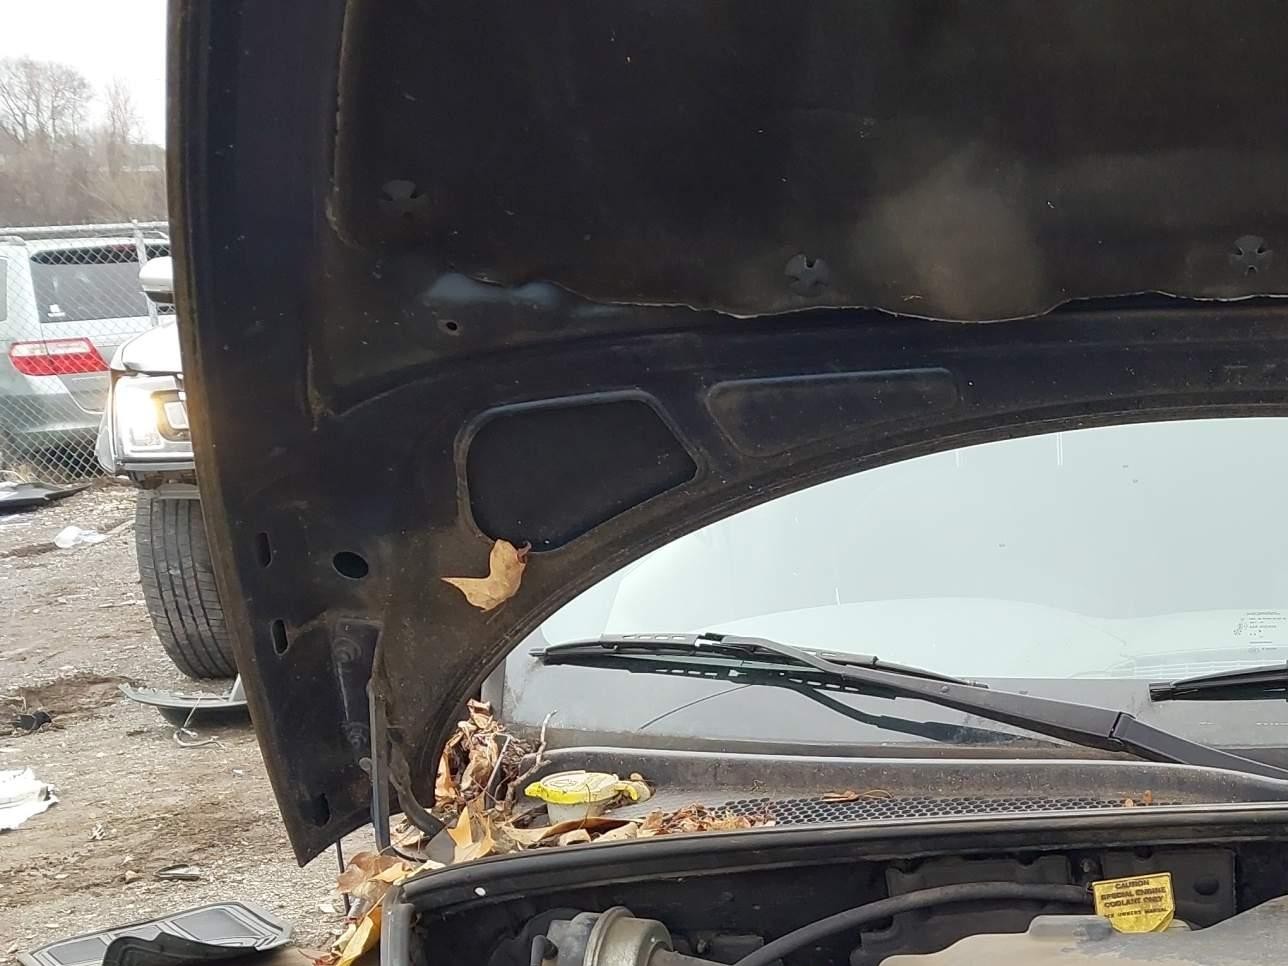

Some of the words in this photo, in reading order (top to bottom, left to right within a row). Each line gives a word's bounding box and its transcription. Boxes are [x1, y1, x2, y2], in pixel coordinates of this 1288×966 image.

[1115, 880, 1150, 890] CAUTION
[1101, 891, 1134, 900] SPECIAL
[1135, 887, 1167, 896] ENGINE
[1104, 898, 1142, 908] COOLANT
